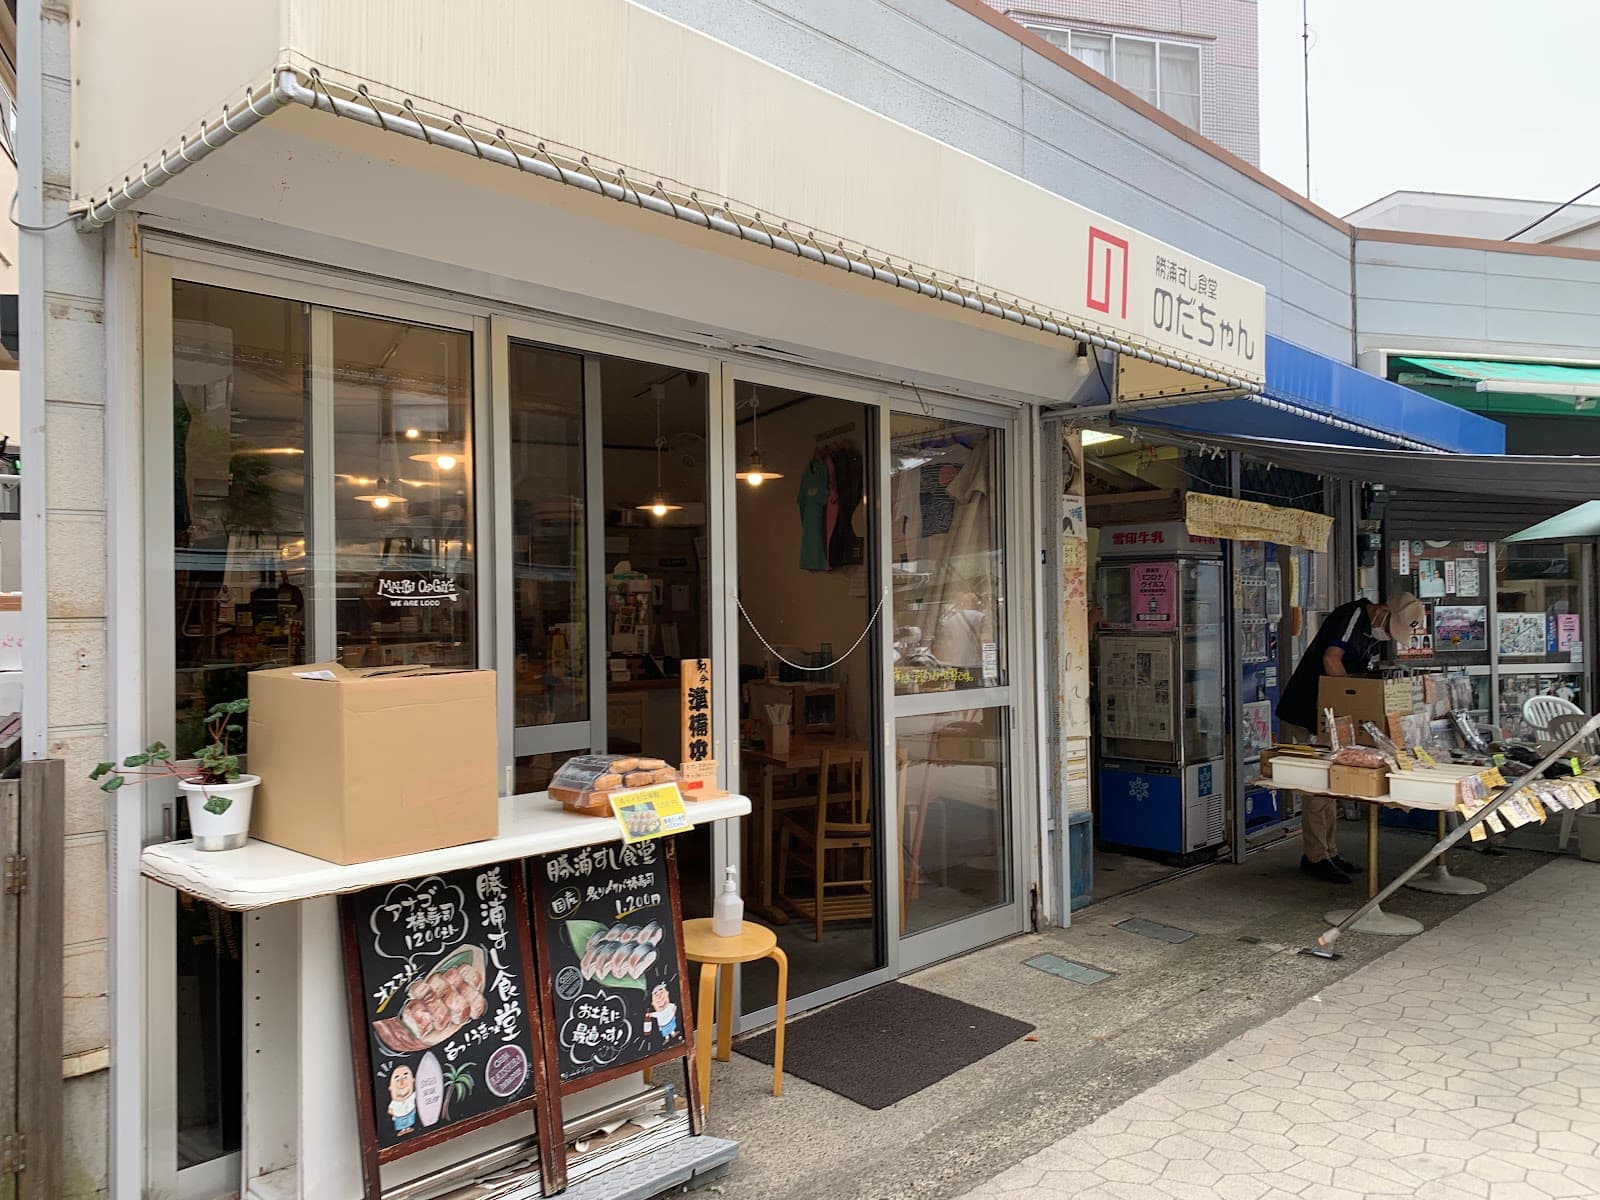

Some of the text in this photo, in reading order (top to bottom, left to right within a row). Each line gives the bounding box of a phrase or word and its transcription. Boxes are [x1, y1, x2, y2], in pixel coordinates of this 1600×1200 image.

[1155, 255, 1218, 300] 勝浦すし食堂
[1153, 287, 1255, 361] のだちゃん
[1112, 531, 1165, 544] 雪印牛乳
[546, 839, 657, 883] 勝浦すし食堂
[384, 886, 438, 922] アナゴ
[405, 903, 455, 932] 棒寿司
[552, 890, 579, 914] 国産
[476, 866, 522, 1041] 勝浦すし食堂
[373, 964, 420, 1006] オススメ
[578, 1003, 621, 1025] お土産に
